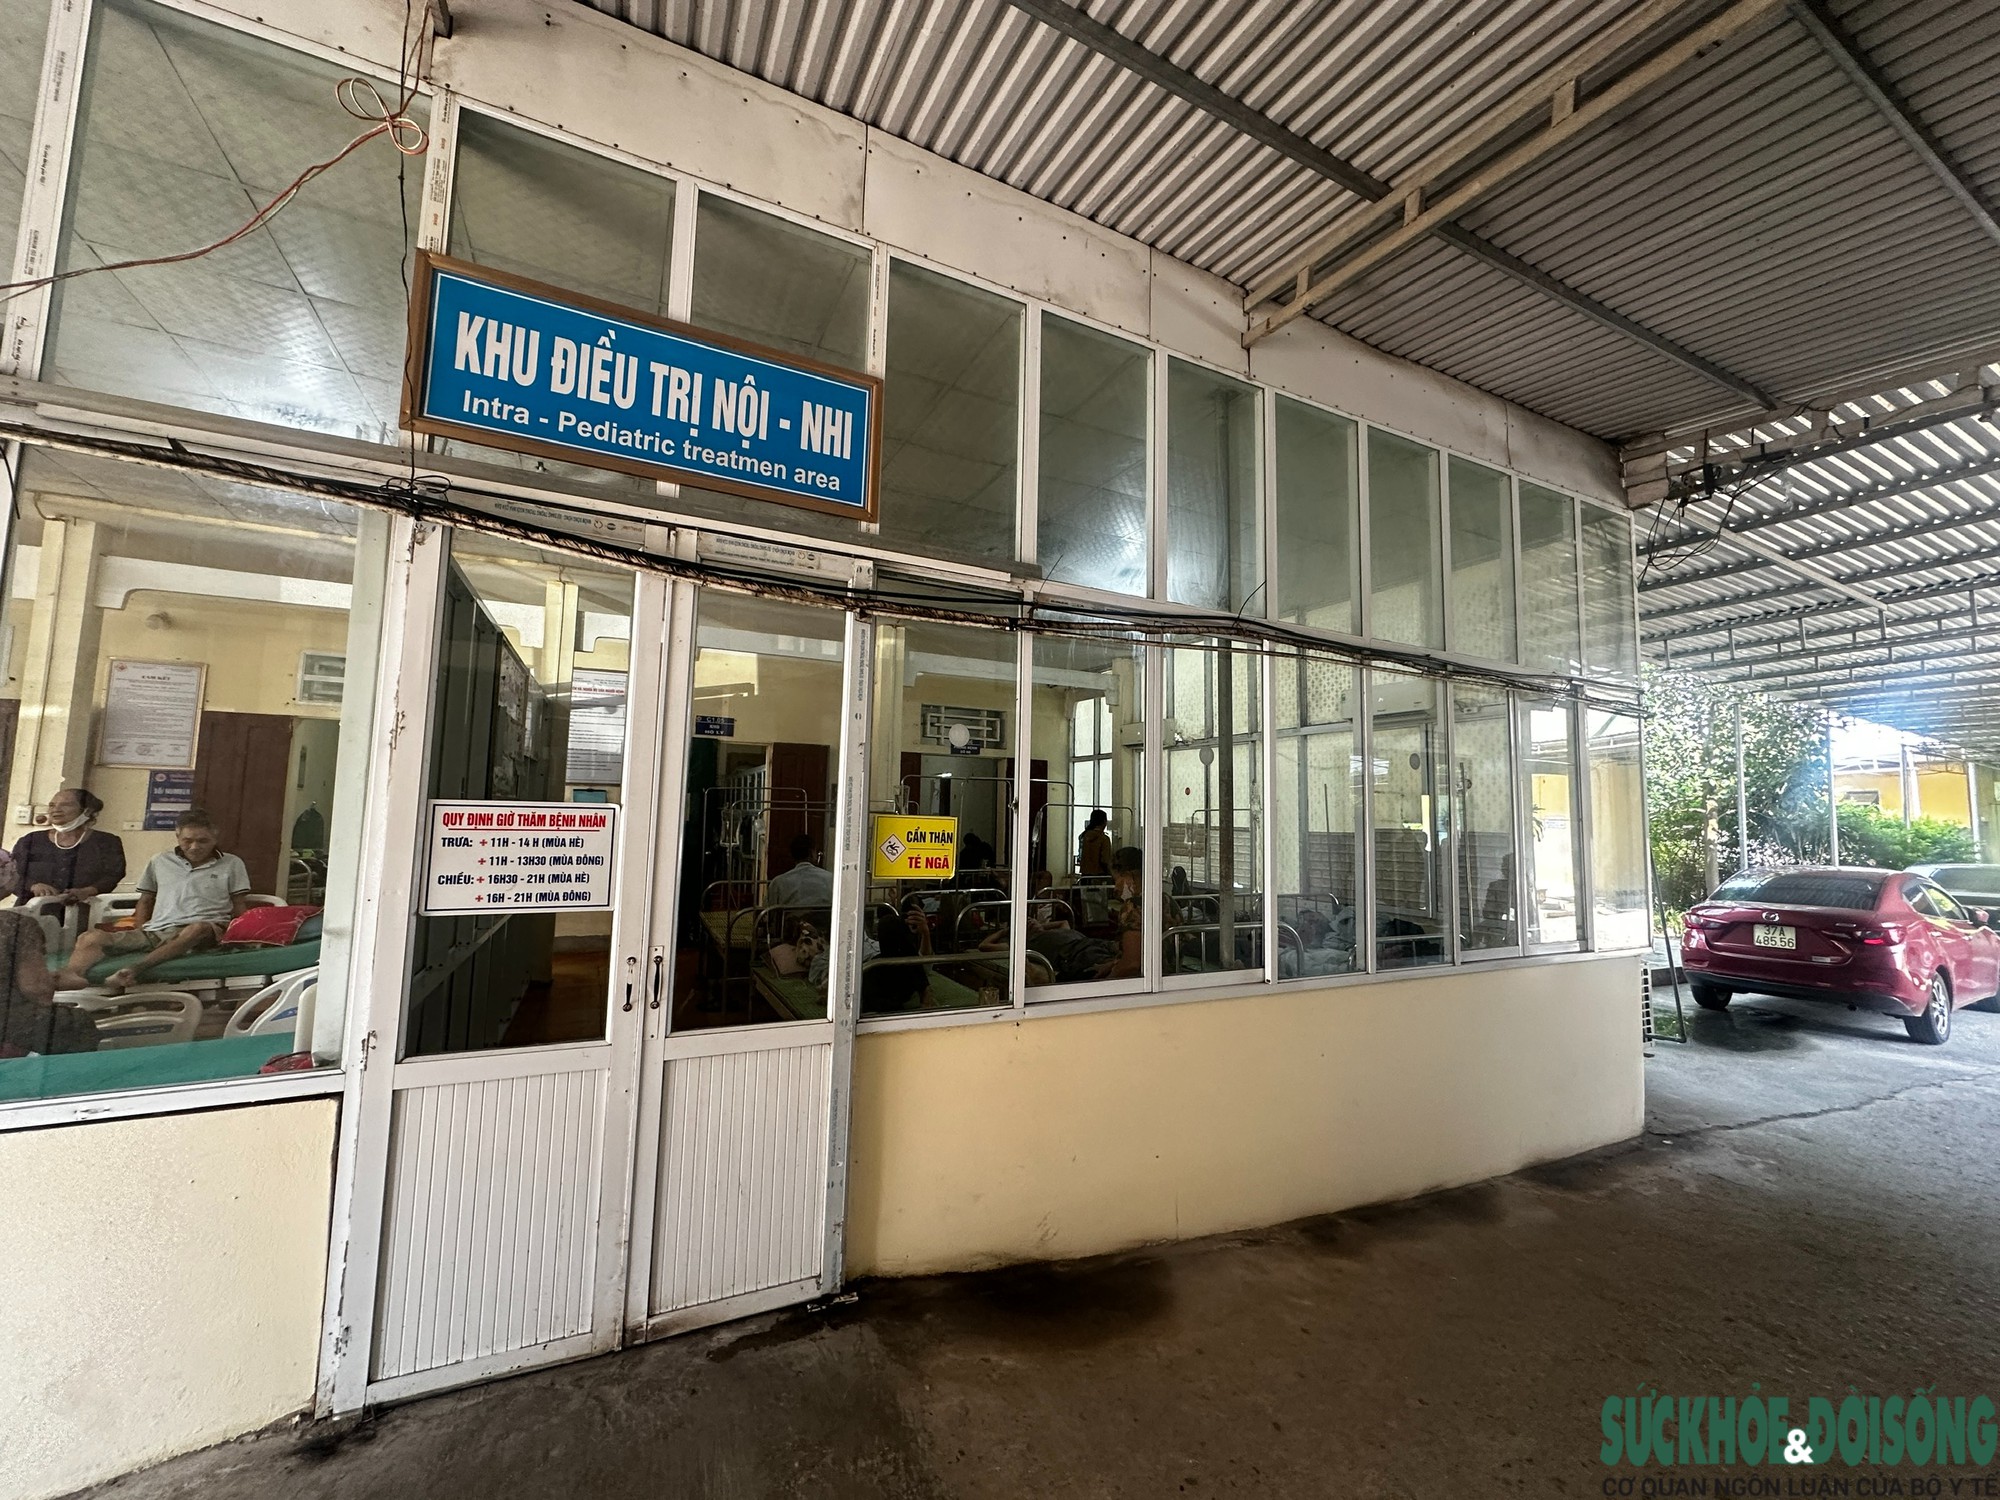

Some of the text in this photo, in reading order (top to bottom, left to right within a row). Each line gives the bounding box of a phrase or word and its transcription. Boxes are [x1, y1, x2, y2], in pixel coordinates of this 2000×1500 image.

[454, 311, 853, 460] KHU ĐIỀU TRỊ NỘI - NHI
[463, 390, 840, 491] Intra - Pediatric treatmen area
[443, 810, 606, 829] QUY ĐỊNH GIỜ THĂM BỆNH NHÂN
[441, 837, 473, 848] TRƯA:
[491, 838, 509, 848] 11H
[518, 838, 530, 848] 14
[532, 838, 539, 848] H
[542, 836, 566, 849] (MÙA
[569, 835, 584, 849] HÈ)
[906, 827, 953, 846] CẨN THẬN
[489, 856, 507, 866] 11H
[517, 856, 546, 866] 13H30
[549, 854, 573, 867] (MÙA
[575, 854, 604, 867] ĐÔNG)
[908, 854, 949, 869] TÉ NGÃ
[488, 874, 518, 884] 16H30
[527, 874, 545, 884] 21H
[548, 872, 572, 885] (MÙA
[574, 872, 590, 885] HÈ)
[486, 893, 505, 903] 16H
[514, 892, 532, 902] 21H
[535, 890, 560, 904] (MÙA
[562, 890, 591, 903] ĐÔNG)
